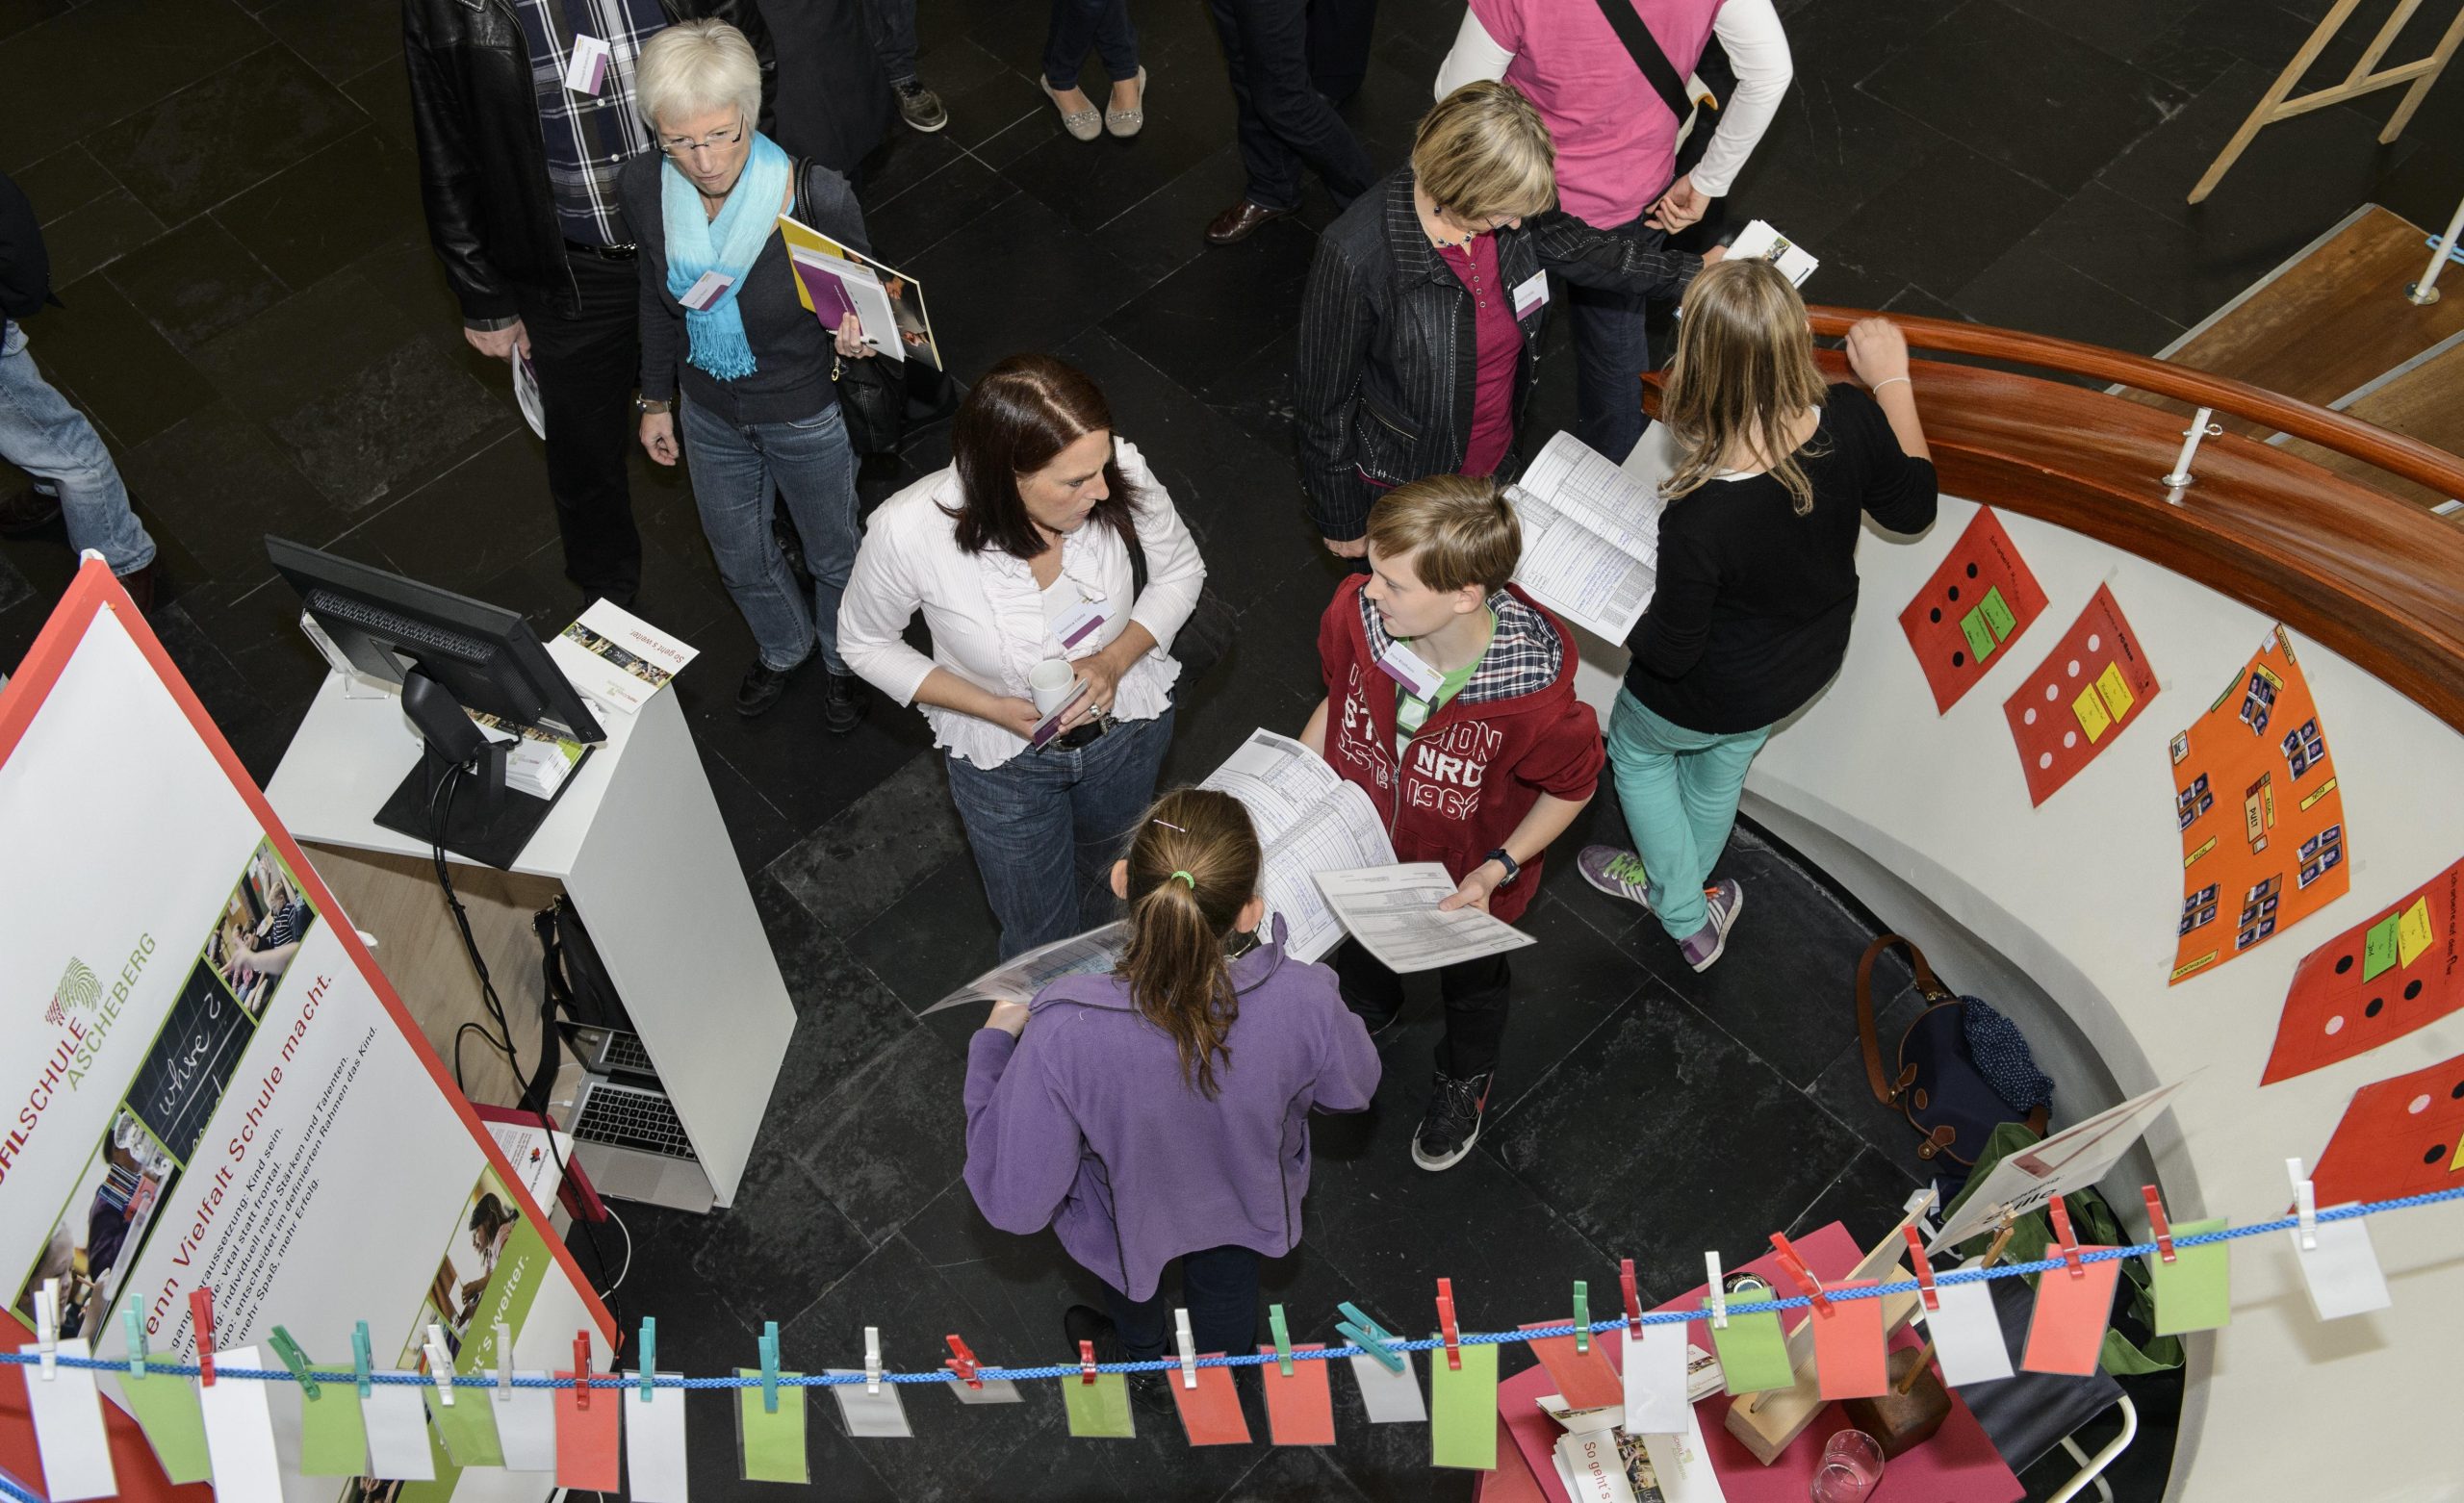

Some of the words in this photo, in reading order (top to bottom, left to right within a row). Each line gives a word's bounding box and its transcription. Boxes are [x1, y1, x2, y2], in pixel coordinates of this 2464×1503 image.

[67, 932, 156, 1091] ASCHEBERG
[146, 1277, 179, 1337] enn
[172, 1164, 234, 1266] Vielfalt
[229, 1064, 283, 1162] Schule
[281, 974, 332, 1062] macht.
[220, 1235, 261, 1310] individuell
[259, 1195, 278, 1235] nach
[275, 1144, 305, 1196] Stärken
[303, 1114, 319, 1142] und
[315, 1057, 348, 1112] Talenten.
[221, 1244, 240, 1277] vital
[239, 1210, 257, 1244] statt
[254, 1162, 282, 1210] frontal.
[235, 1233, 278, 1316] entscheidet
[274, 1213, 287, 1232] im
[285, 1139, 322, 1211] definierten
[319, 1084, 348, 1138] Rahmen
[346, 1058, 361, 1083] das
[358, 1027, 377, 1057] Kind.
[246, 1159, 267, 1192] Kind
[264, 1128, 284, 1159] sein.
[239, 1303, 259, 1341] mehr
[256, 1261, 280, 1300] Spaß,
[277, 1220, 297, 1258] mehr
[295, 1179, 320, 1219] Erfolg.
[490, 1255, 529, 1332] weiter.
[1584, 1441, 1597, 1459] So
[1588, 1462, 1611, 1500] geht´s
